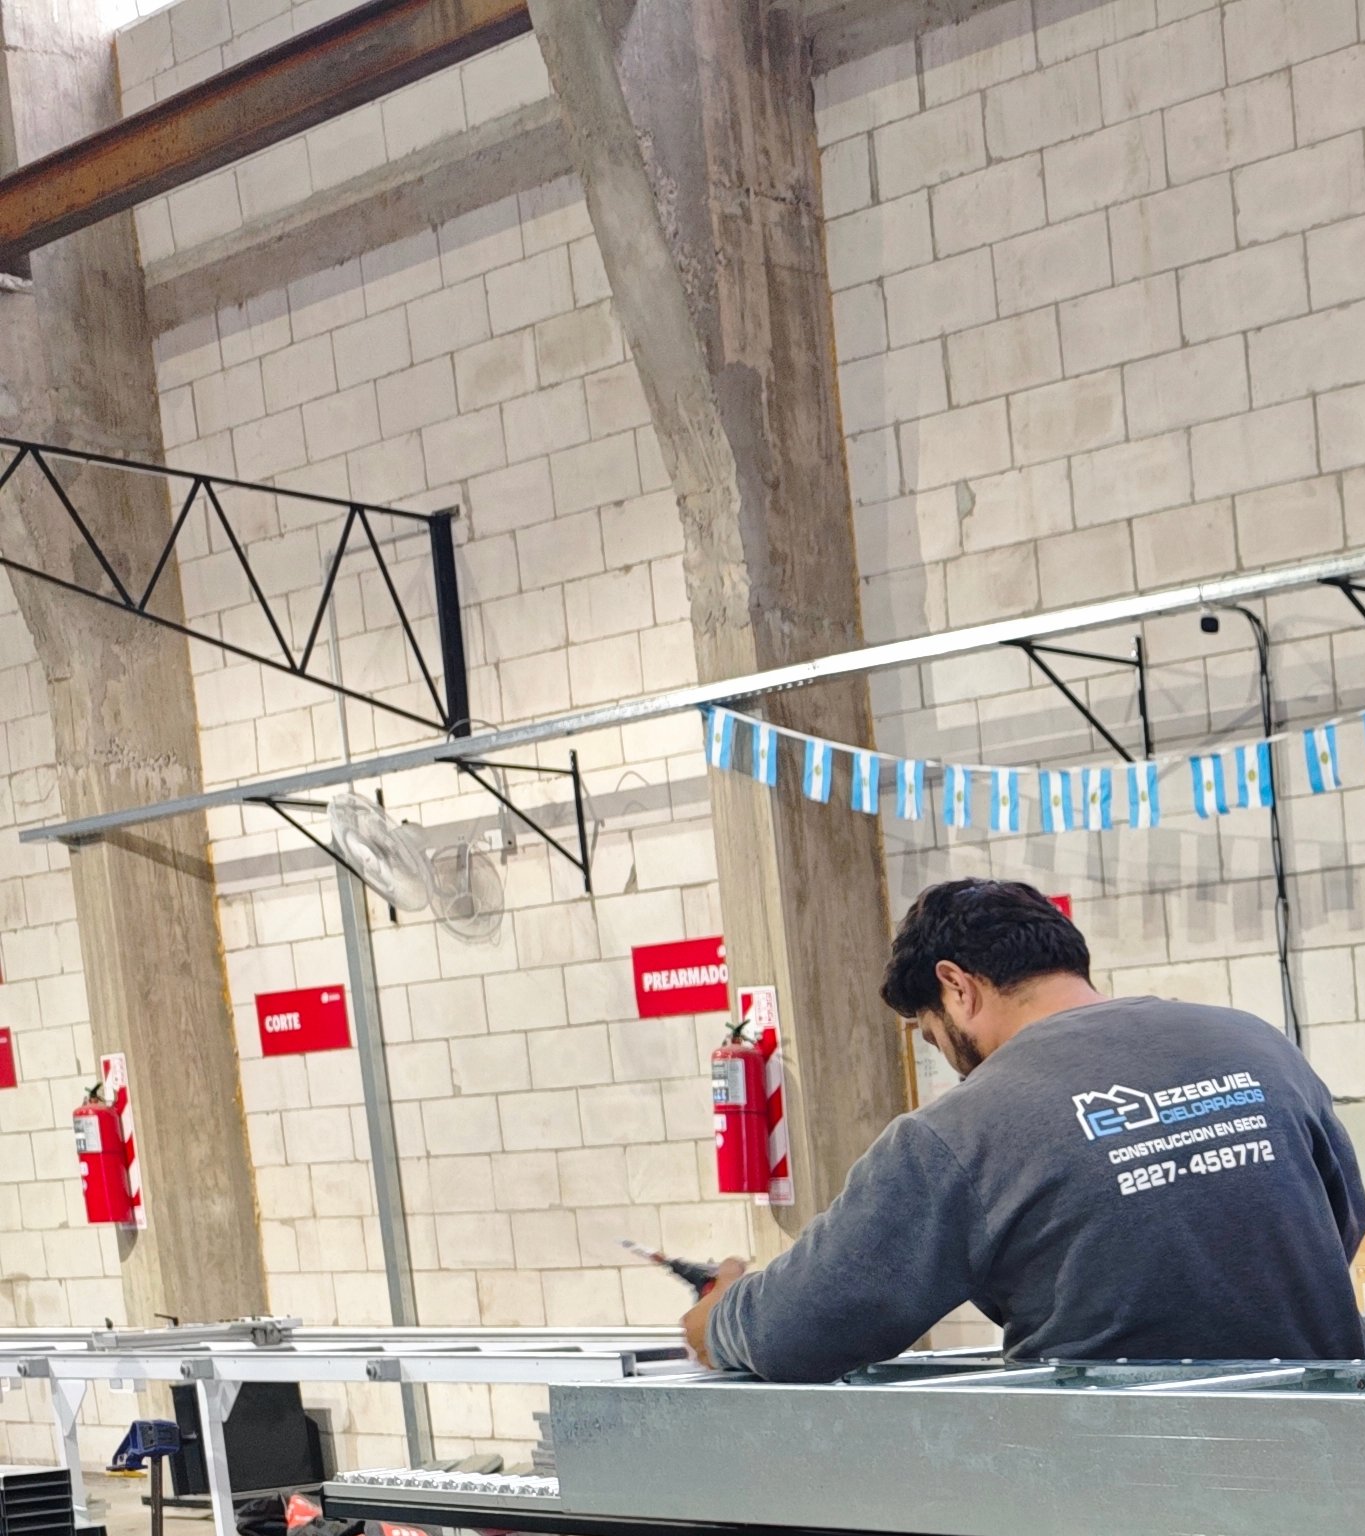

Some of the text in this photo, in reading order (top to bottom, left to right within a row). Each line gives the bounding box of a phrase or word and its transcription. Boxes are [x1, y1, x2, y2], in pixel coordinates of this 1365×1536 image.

[642, 963, 729, 992] PREARMADO
[264, 1011, 301, 1033] CORTE
[1154, 1071, 1261, 1107] EZEQUIEL
[1159, 1088, 1265, 1125] CIELORRASOS
[1108, 1114, 1268, 1164] CONSTRUCCION EN SECO
